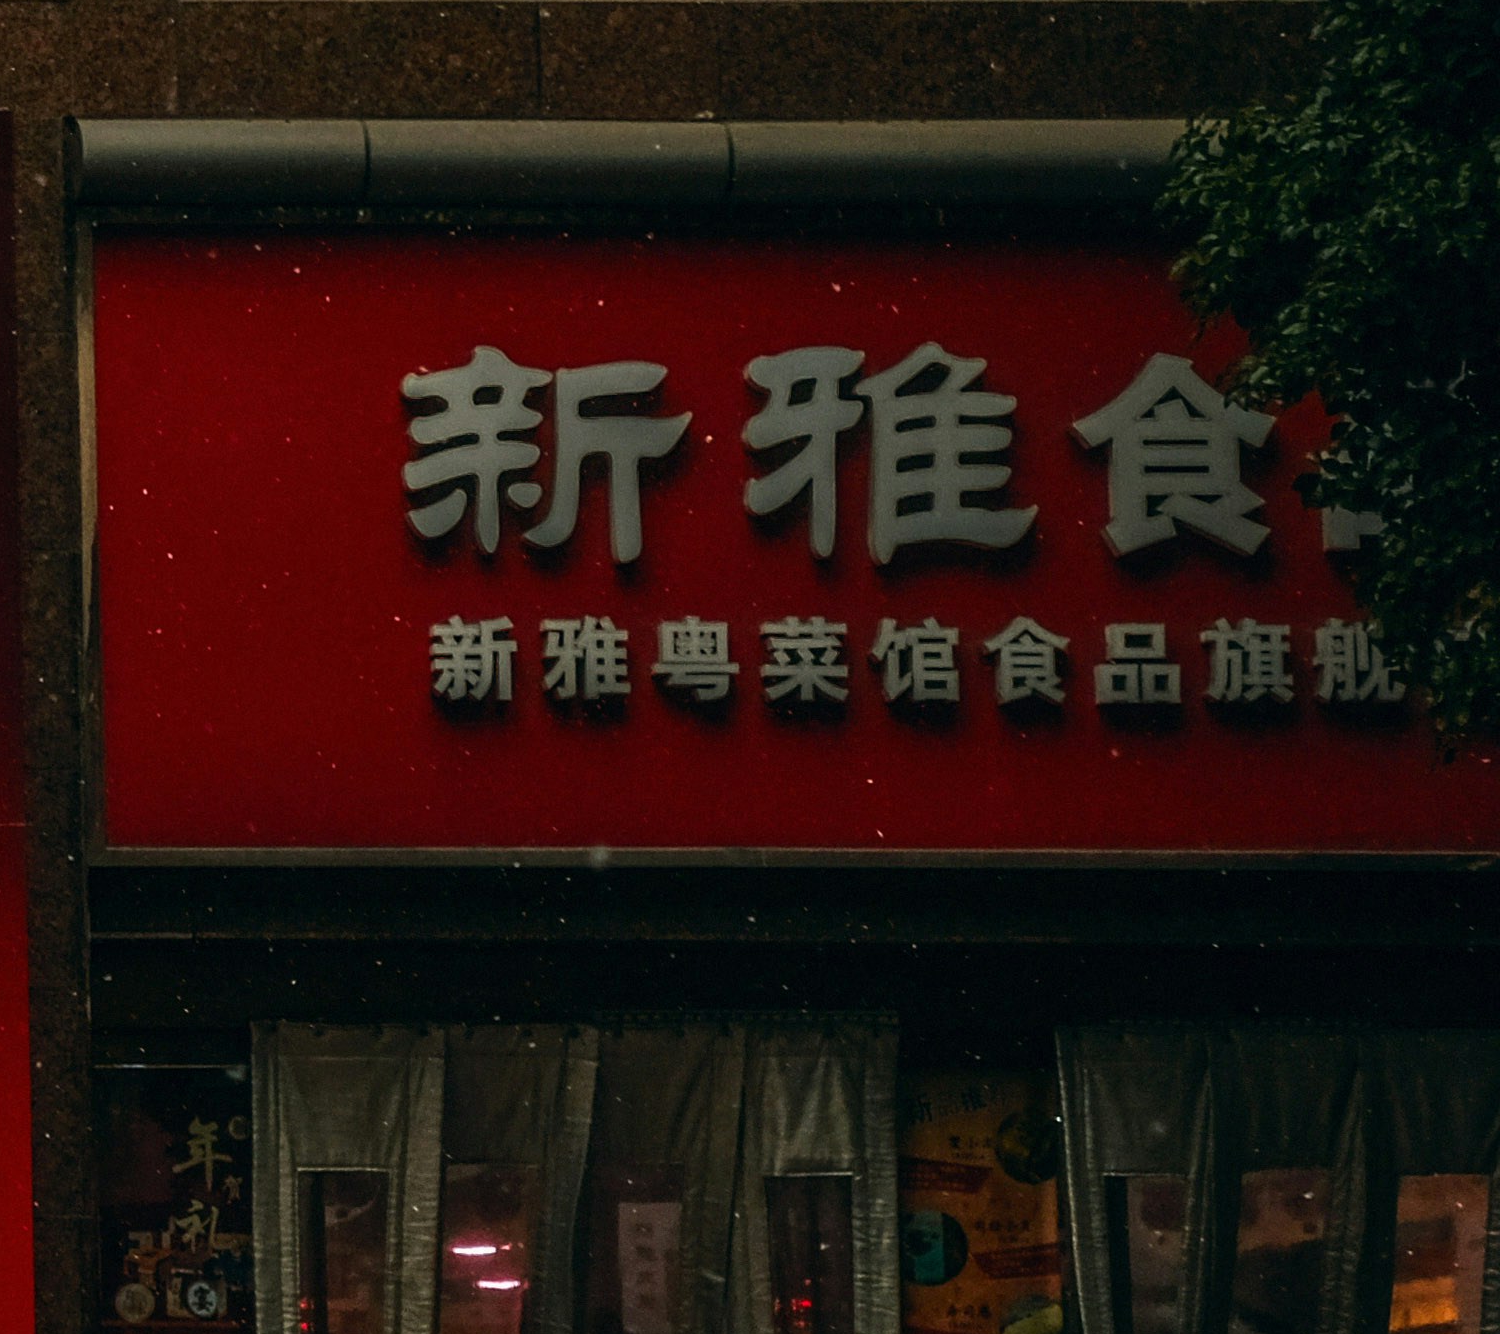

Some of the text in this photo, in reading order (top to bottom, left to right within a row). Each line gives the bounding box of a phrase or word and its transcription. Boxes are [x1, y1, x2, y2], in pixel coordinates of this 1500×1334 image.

[398, 342, 1384, 564] 新雅食
[429, 614, 1406, 707] 新雅粤菜馆食品旗舰
